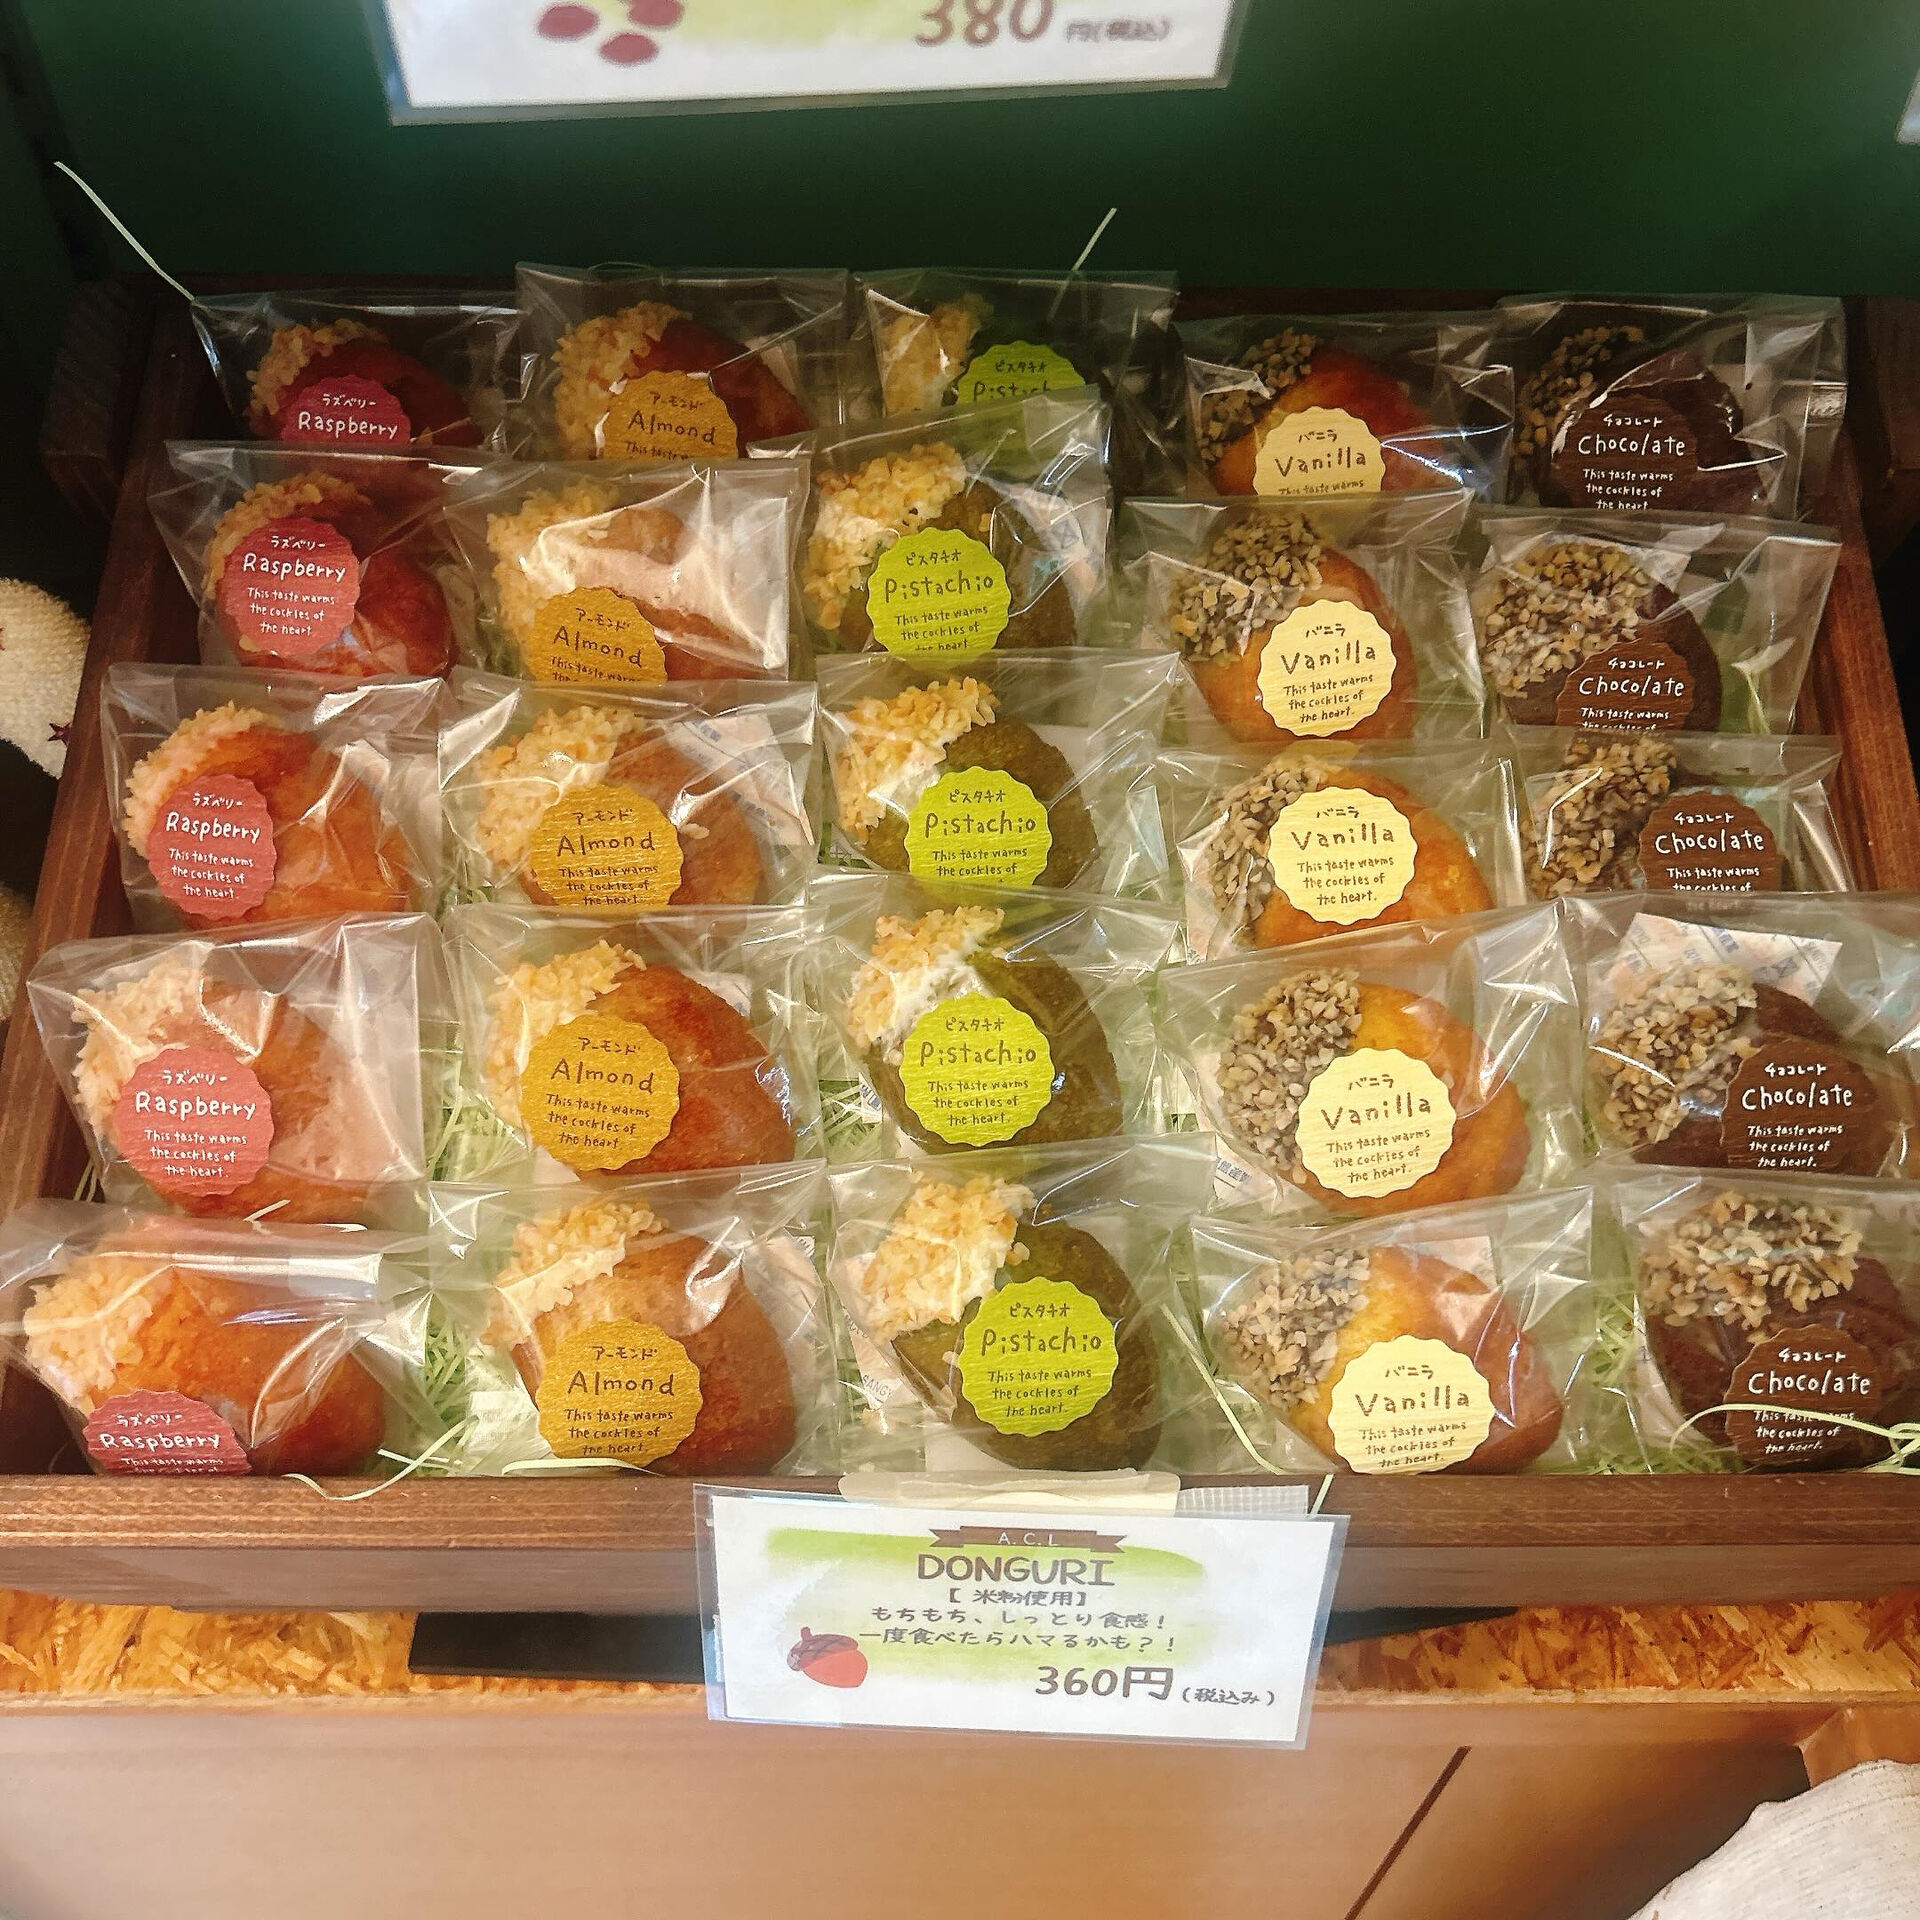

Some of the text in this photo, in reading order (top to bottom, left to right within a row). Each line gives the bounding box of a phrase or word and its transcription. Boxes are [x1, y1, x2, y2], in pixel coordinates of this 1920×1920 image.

[914, 0, 1052, 46] 380
[323, 394, 376, 408] ラズベリー
[298, 411, 398, 439] Raspberry
[628, 410, 715, 446] Almond
[1603, 414, 1663, 427] チョコレート
[1298, 429, 1337, 443] バニラ
[1578, 433, 1686, 456] Chocolate
[1274, 447, 1366, 477] Vanilla
[1583, 468, 1674, 481] This taste warms
[271, 536, 326, 550] ラズベリー
[906, 548, 962, 566] ピスタチオ
[243, 552, 346, 582] Raspberry
[885, 570, 994, 603] Pistachio
[248, 587, 335, 605] This taste warms
[250, 603, 324, 621] the cockles of
[576, 607, 630, 632] アーモンド
[895, 606, 988, 626] This taste warms
[1306, 623, 1346, 638] バニラ
[553, 625, 642, 668] Almond
[1281, 640, 1376, 674] Vanilla
[1608, 657, 1665, 670] チョコレート
[1284, 675, 1373, 696] This taste warms
[1578, 675, 1684, 697] Chocolate
[1289, 690, 1364, 710] the cockles of
[1580, 707, 1669, 720] This taste warms
[192, 792, 243, 809] ラズベリー
[950, 789, 1006, 804] ピスタチオ
[572, 809, 633, 825] アーモンド
[1316, 806, 1360, 819] バニラ
[1674, 812, 1734, 825] チョコレート
[166, 811, 260, 844] Raspberry
[925, 810, 1036, 838] Pistachio
[557, 832, 655, 857] Almond
[1291, 822, 1394, 850] Vanilla
[1655, 829, 1764, 854] Chocolate
[169, 848, 254, 868] This taste warms
[932, 848, 1027, 861] This taste warms
[558, 865, 658, 879] This taste warms
[936, 863, 1018, 876] the cockles of
[1297, 857, 1394, 873] This taste warms
[1666, 867, 1760, 879] This taste warms
[172, 866, 245, 884] the cockles of
[1303, 873, 1385, 888] the cockles of
[946, 1017, 1004, 1031] ピスタチオ
[578, 1037, 640, 1055] アーモンド
[920, 1040, 1036, 1067] Pistachio
[162, 1069, 228, 1086] ラズベリー
[550, 1058, 654, 1094] Almond
[1764, 1062, 1827, 1078] チョコレート
[928, 1080, 1029, 1092] This taste warms
[1348, 1074, 1394, 1090] バニラ
[933, 1096, 1019, 1108] the cockles of
[1741, 1082, 1852, 1110] Chocolate
[135, 1091, 256, 1122] Raspberry
[546, 1094, 650, 1118] This taste warms
[1321, 1092, 1431, 1130] Vanilla
[548, 1111, 636, 1134] the cockles of
[1748, 1125, 1843, 1137] This taste warms
[144, 1129, 247, 1145] This taste warms
[1326, 1129, 1430, 1154] This taste warms
[1750, 1140, 1830, 1152] the cockles of
[150, 1147, 236, 1163] the cockles of
[1010, 1302, 1070, 1317] ピスタチオ
[981, 1326, 1102, 1356] Pistachio
[592, 1346, 658, 1360] アーモンド
[1778, 1348, 1846, 1363] チョコレート
[988, 1369, 1092, 1383] This taste warms
[1385, 1365, 1434, 1380] バニラ
[567, 1370, 674, 1396] Almond
[1748, 1370, 1871, 1395] Chocolate
[992, 1385, 1079, 1399] the cockles of
[1355, 1385, 1470, 1416] Vanilla
[117, 1414, 182, 1427] ラズベリー
[565, 1409, 673, 1422] This taste warms
[568, 1427, 660, 1438] the cockles of
[100, 1432, 220, 1452] Raspberry
[917, 1554, 1116, 1586] DONGURI
[1034, 1666, 1174, 1700] 360円
